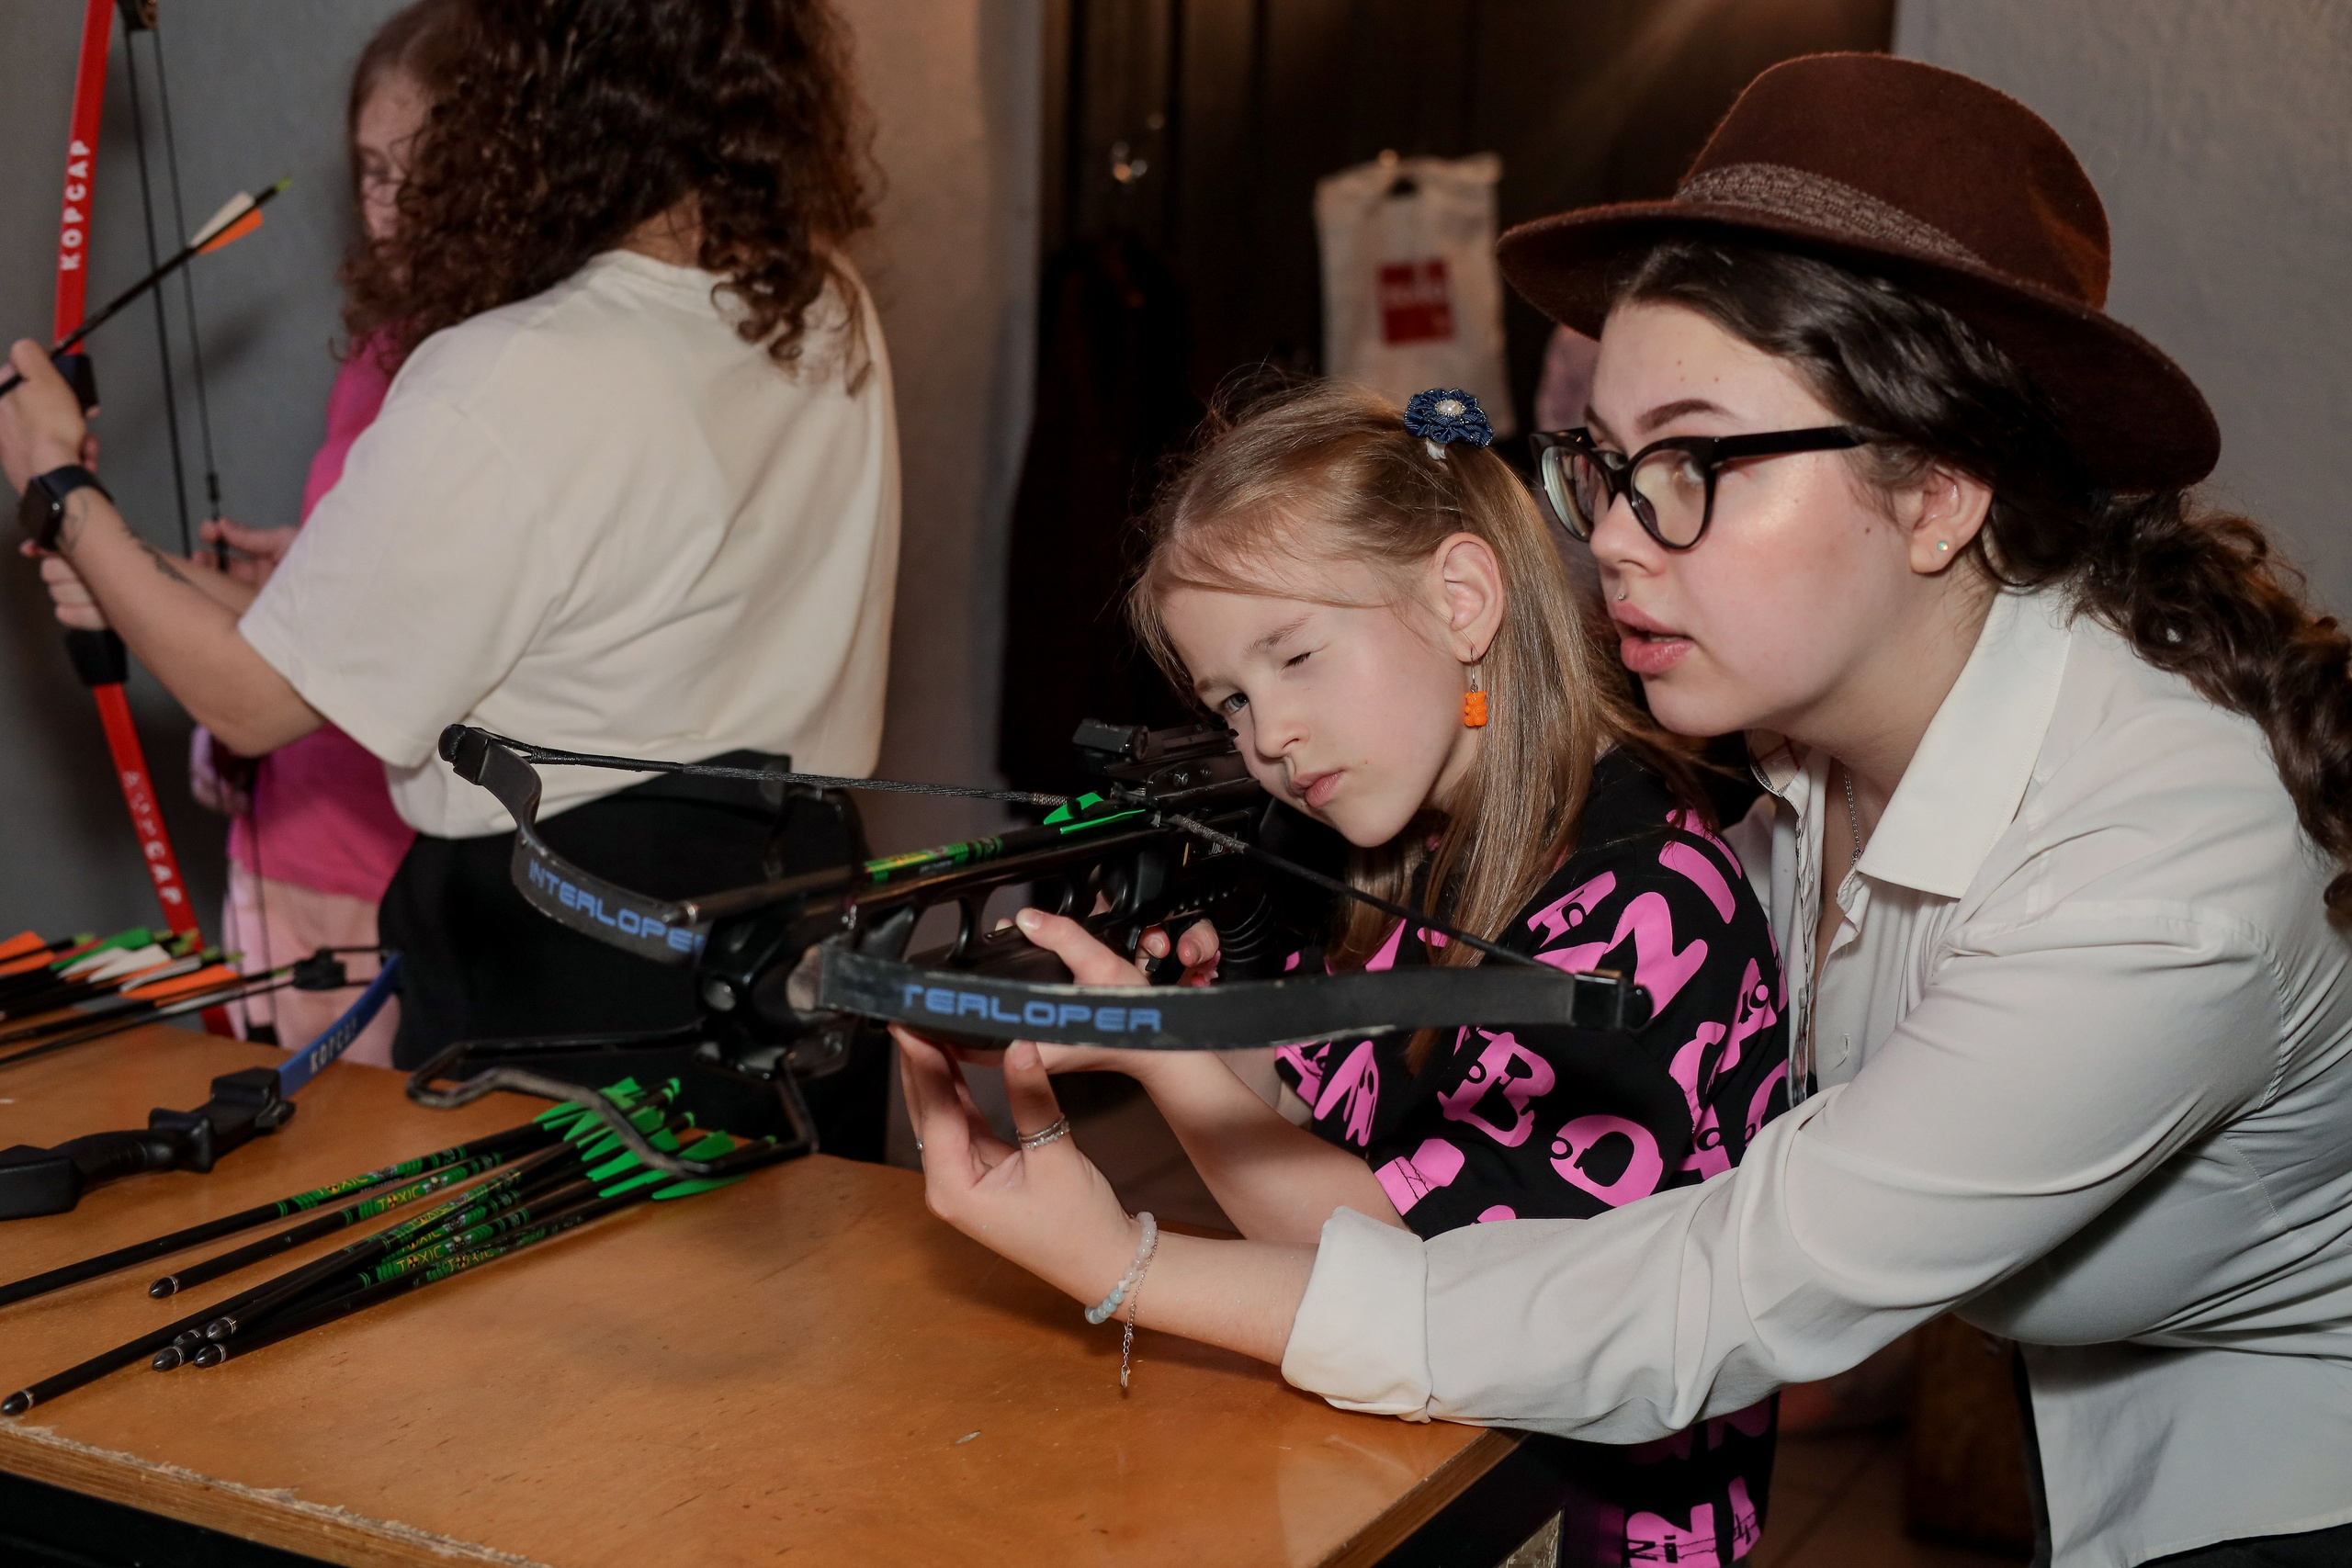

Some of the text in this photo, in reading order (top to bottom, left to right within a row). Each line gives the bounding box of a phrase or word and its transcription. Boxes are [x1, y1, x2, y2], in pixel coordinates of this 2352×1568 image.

[59, 139, 91, 271] КОРСАР
[902, 984, 1162, 1033] TERLOPER
[377, 1184, 421, 1212] TOXIC
[396, 1244, 444, 1271] TOXIC
